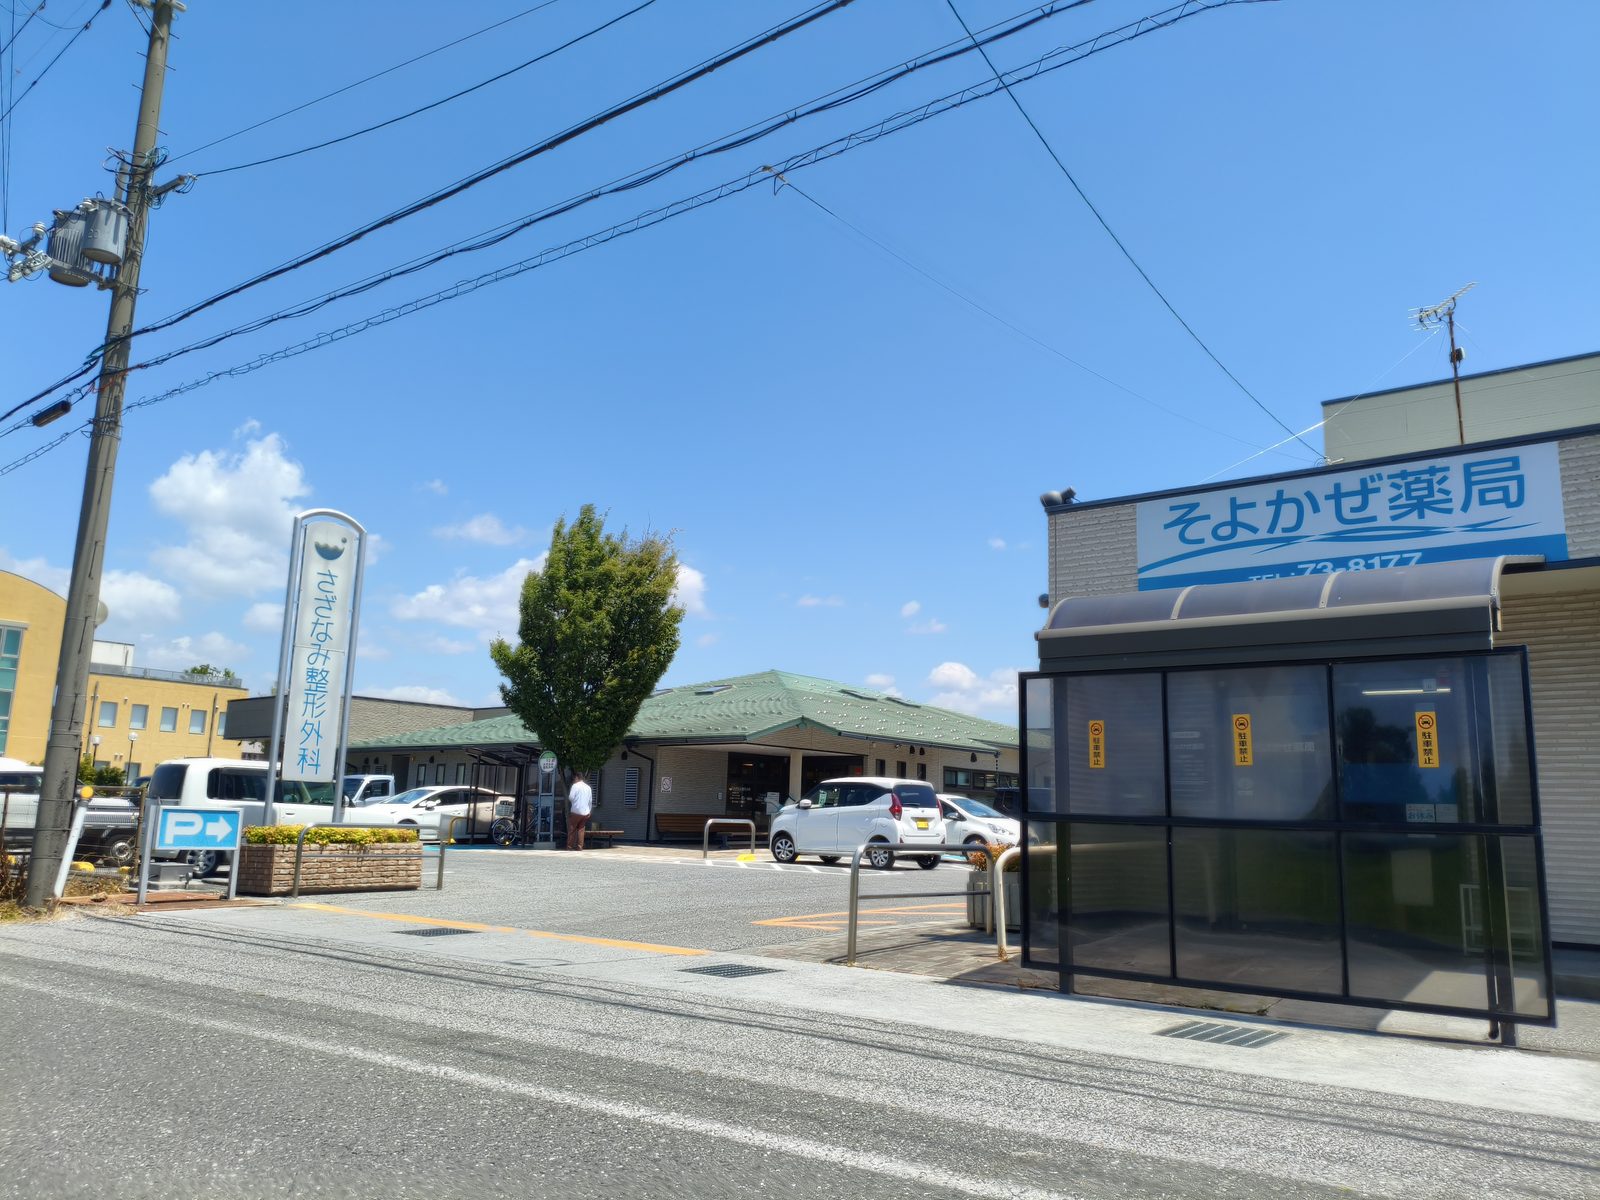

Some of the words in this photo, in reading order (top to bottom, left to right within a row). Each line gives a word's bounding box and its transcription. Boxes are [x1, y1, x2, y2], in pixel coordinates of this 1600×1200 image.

[1163, 455, 1525, 545] そよかぜ薬局
[296, 568, 339, 776] さざなみ整形外科
[1237, 732, 1249, 763] 駐車禁止
[1421, 731, 1435, 765] 駐車禁止
[164, 812, 204, 845] P
